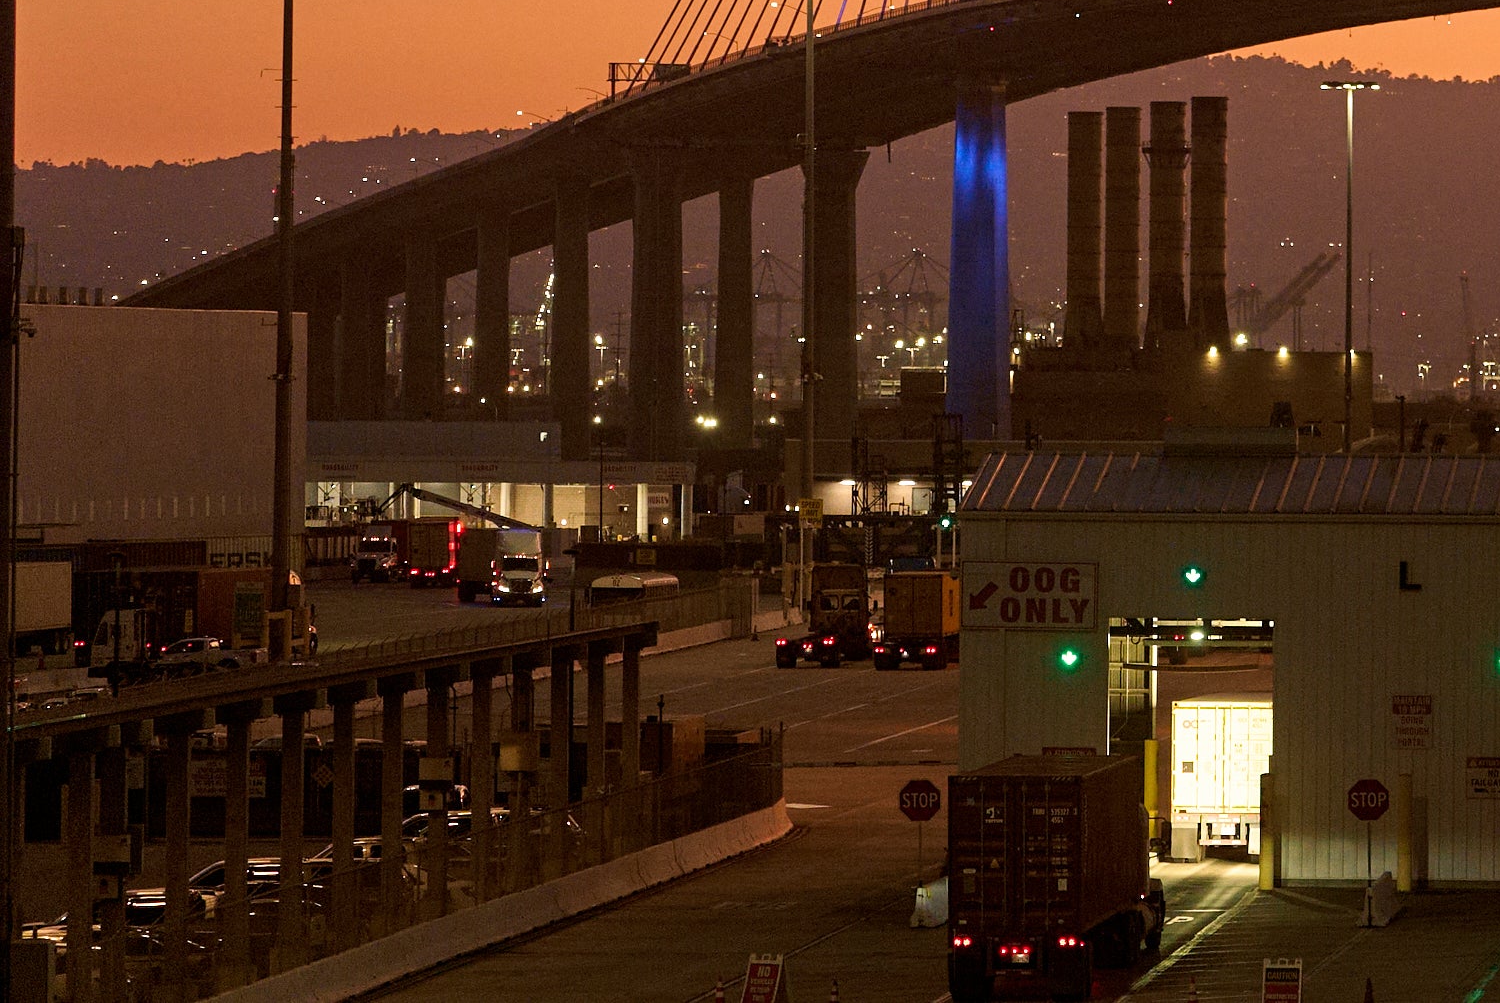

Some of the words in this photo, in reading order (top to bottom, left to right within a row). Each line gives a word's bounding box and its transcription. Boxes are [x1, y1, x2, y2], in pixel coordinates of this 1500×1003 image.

[1009, 566, 1080, 593] OOG
[1400, 562, 1421, 589] L
[1000, 597, 1089, 623] ONLY
[902, 792, 938, 808] STOP
[1351, 792, 1387, 807] STOP
[757, 966, 771, 977] NO
[1267, 971, 1298, 980] CAUTION
